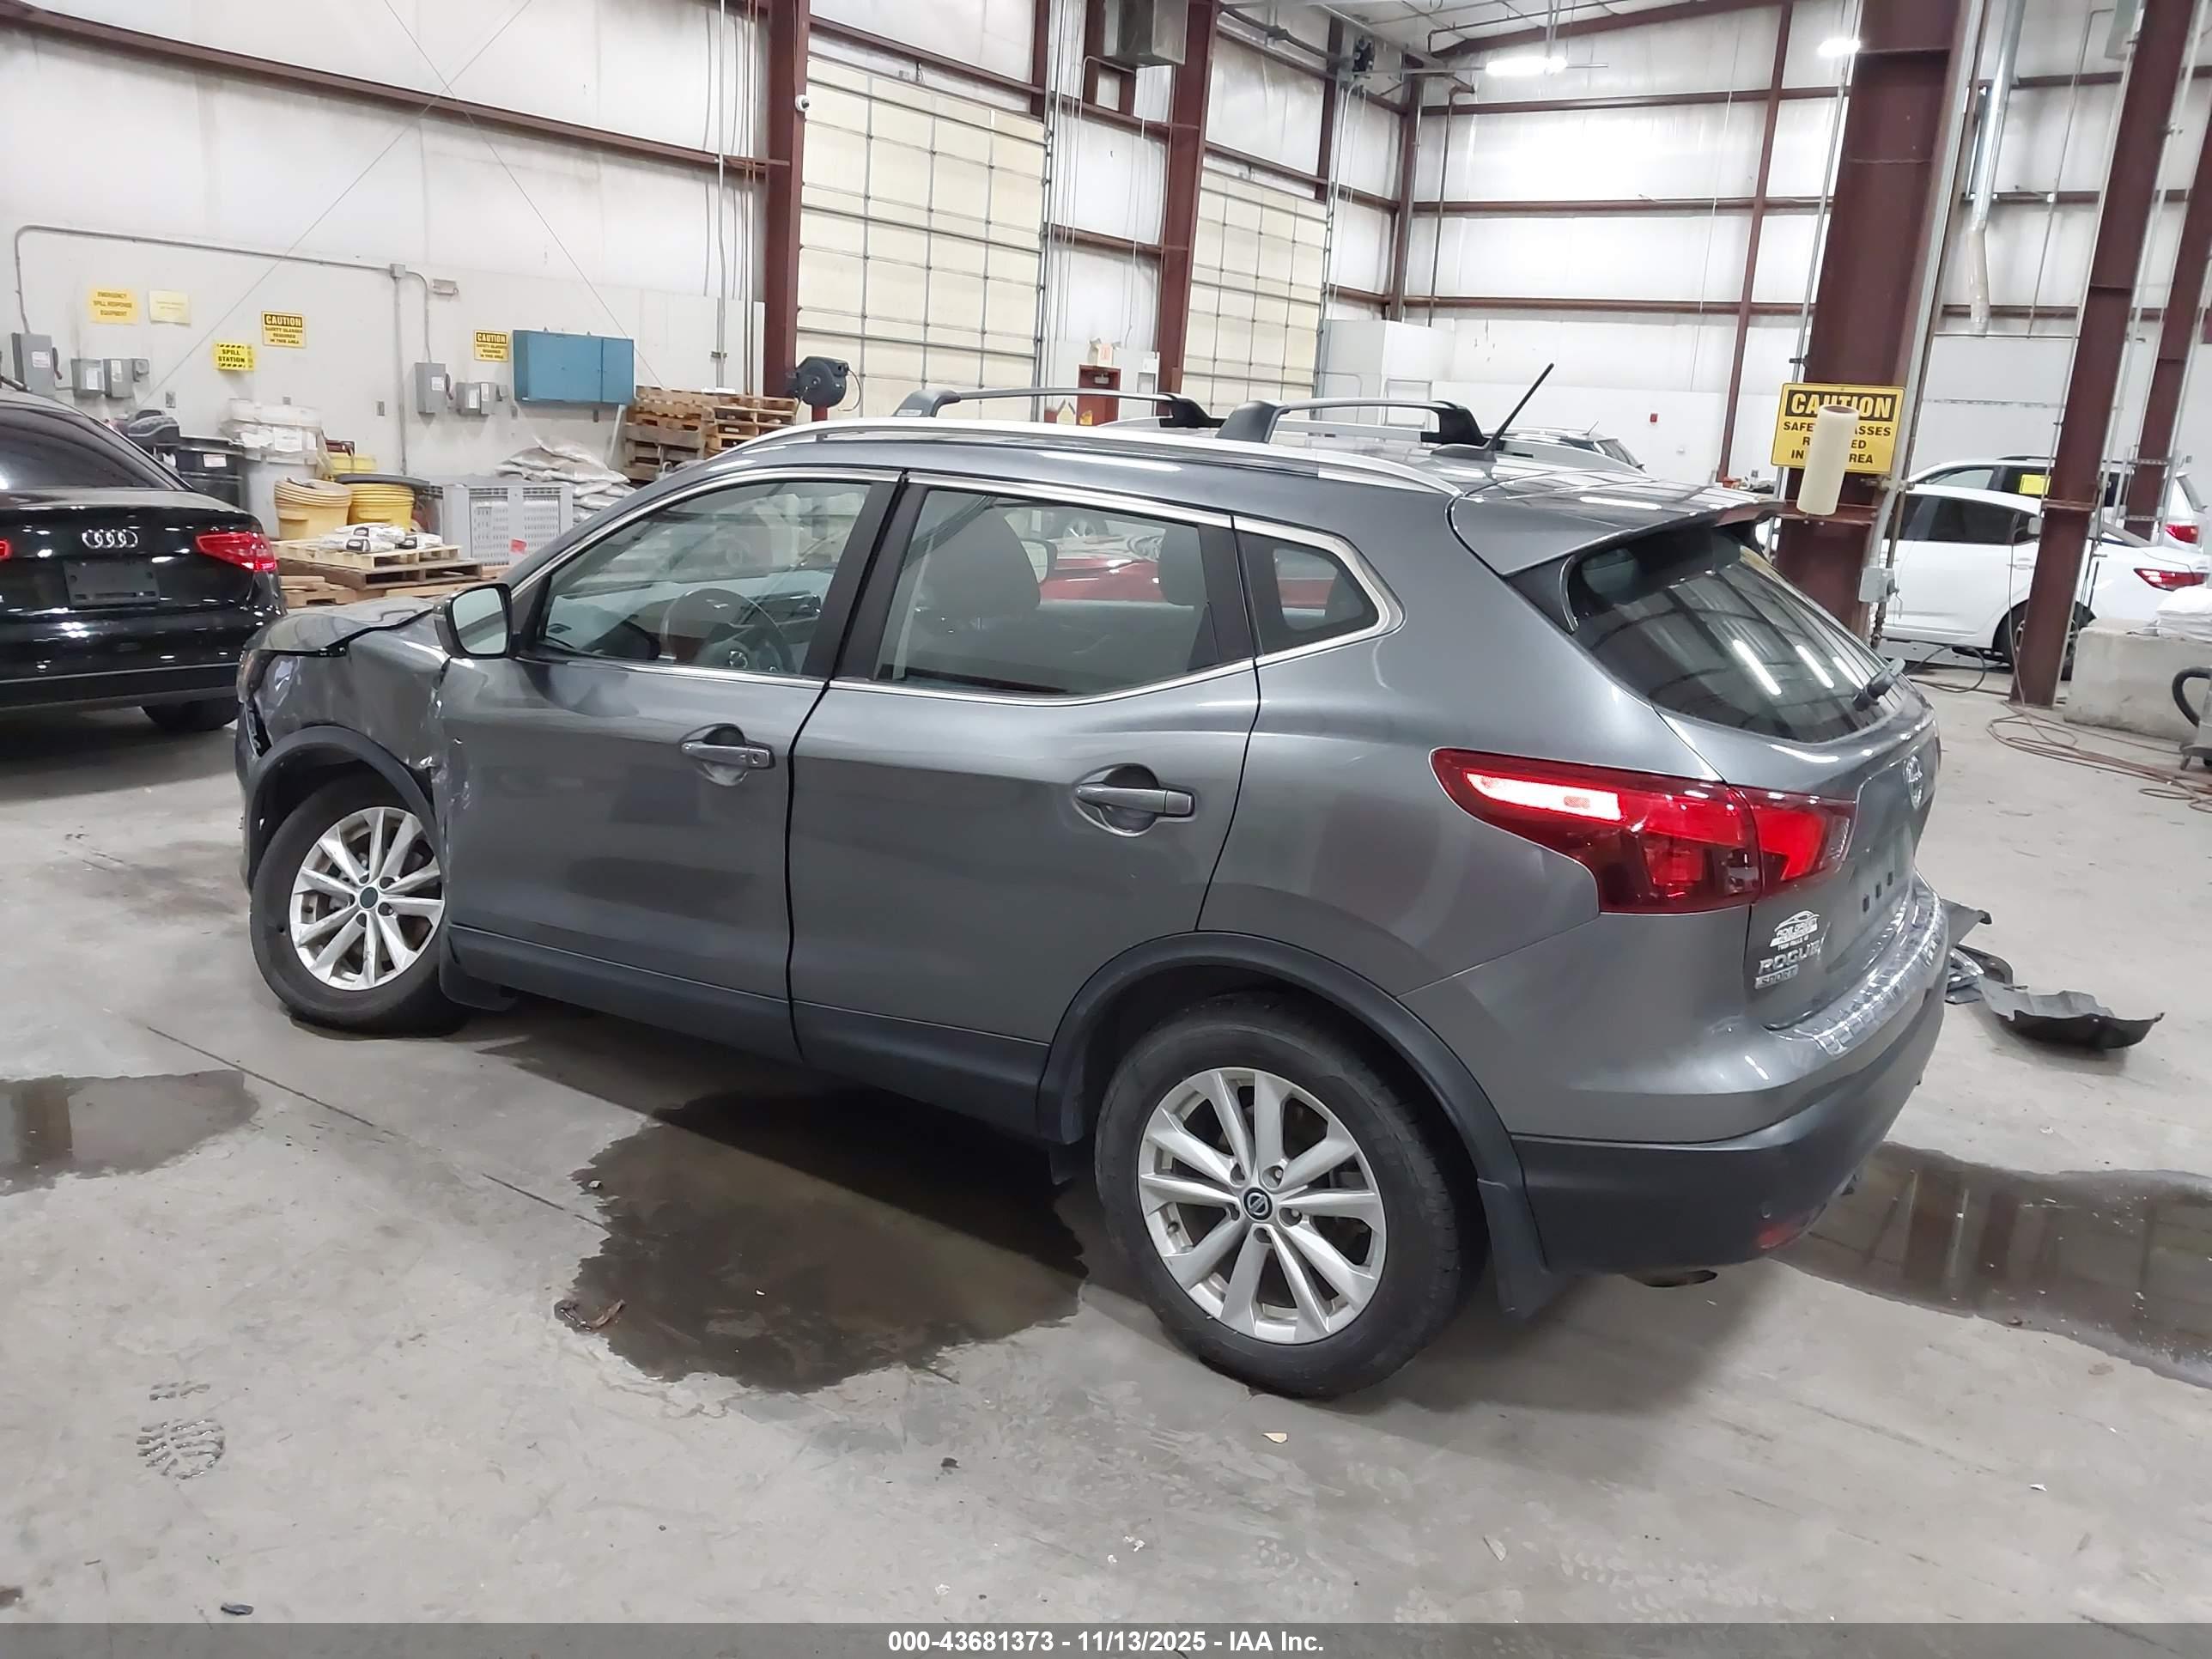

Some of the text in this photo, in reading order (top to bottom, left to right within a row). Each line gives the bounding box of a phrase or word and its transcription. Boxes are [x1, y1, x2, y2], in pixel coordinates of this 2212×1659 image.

[265, 315, 301, 326] CAUTION
[477, 333, 506, 343] CAUTION
[1783, 421, 1892, 437] SAFE SSES
[1790, 449, 1804, 459] IN
[1848, 453, 1874, 464] REA
[1758, 939, 1820, 975] ROGUE
[1759, 965, 1799, 987] SPORT
